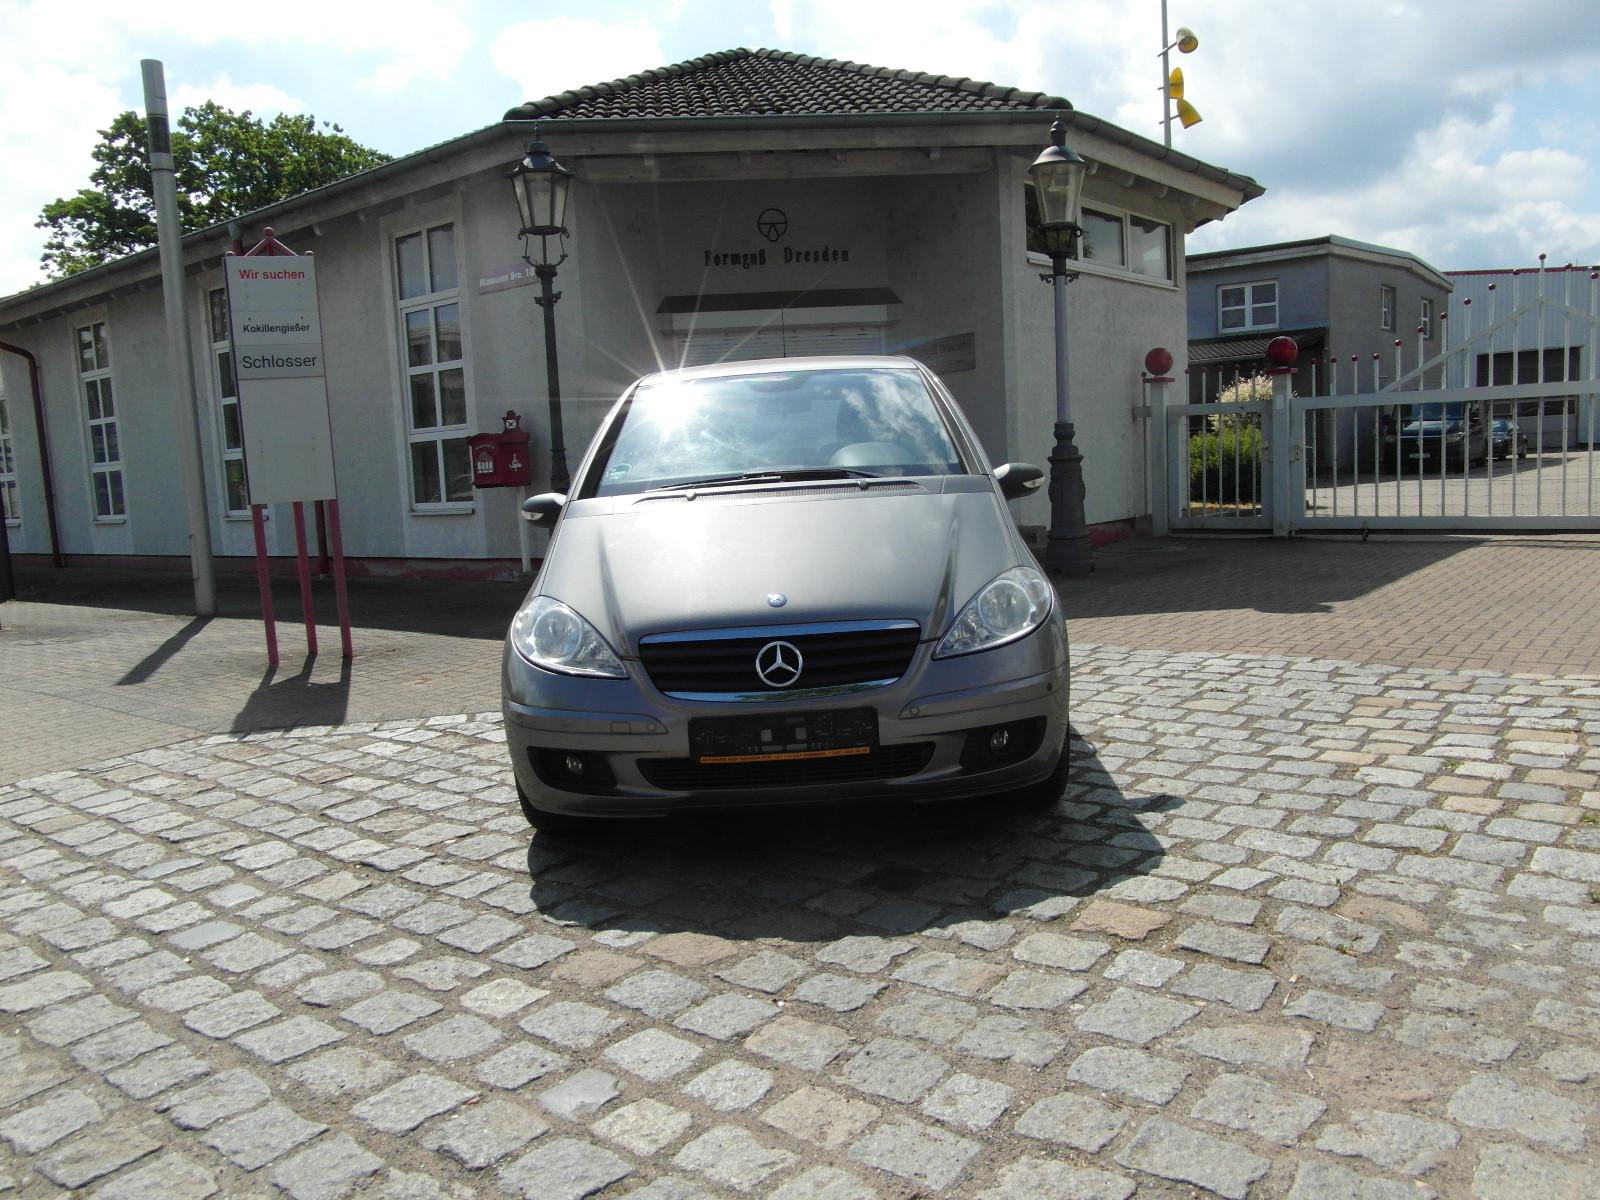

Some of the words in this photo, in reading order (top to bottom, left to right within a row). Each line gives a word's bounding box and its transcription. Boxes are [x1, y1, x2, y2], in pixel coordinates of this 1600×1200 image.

[704, 248, 766, 269] Formguß
[784, 246, 849, 263] Dresden
[239, 269, 259, 279] Wir
[263, 269, 305, 279] suchen
[243, 323, 310, 334] Kokillengießer
[242, 355, 317, 369] Schlosser
